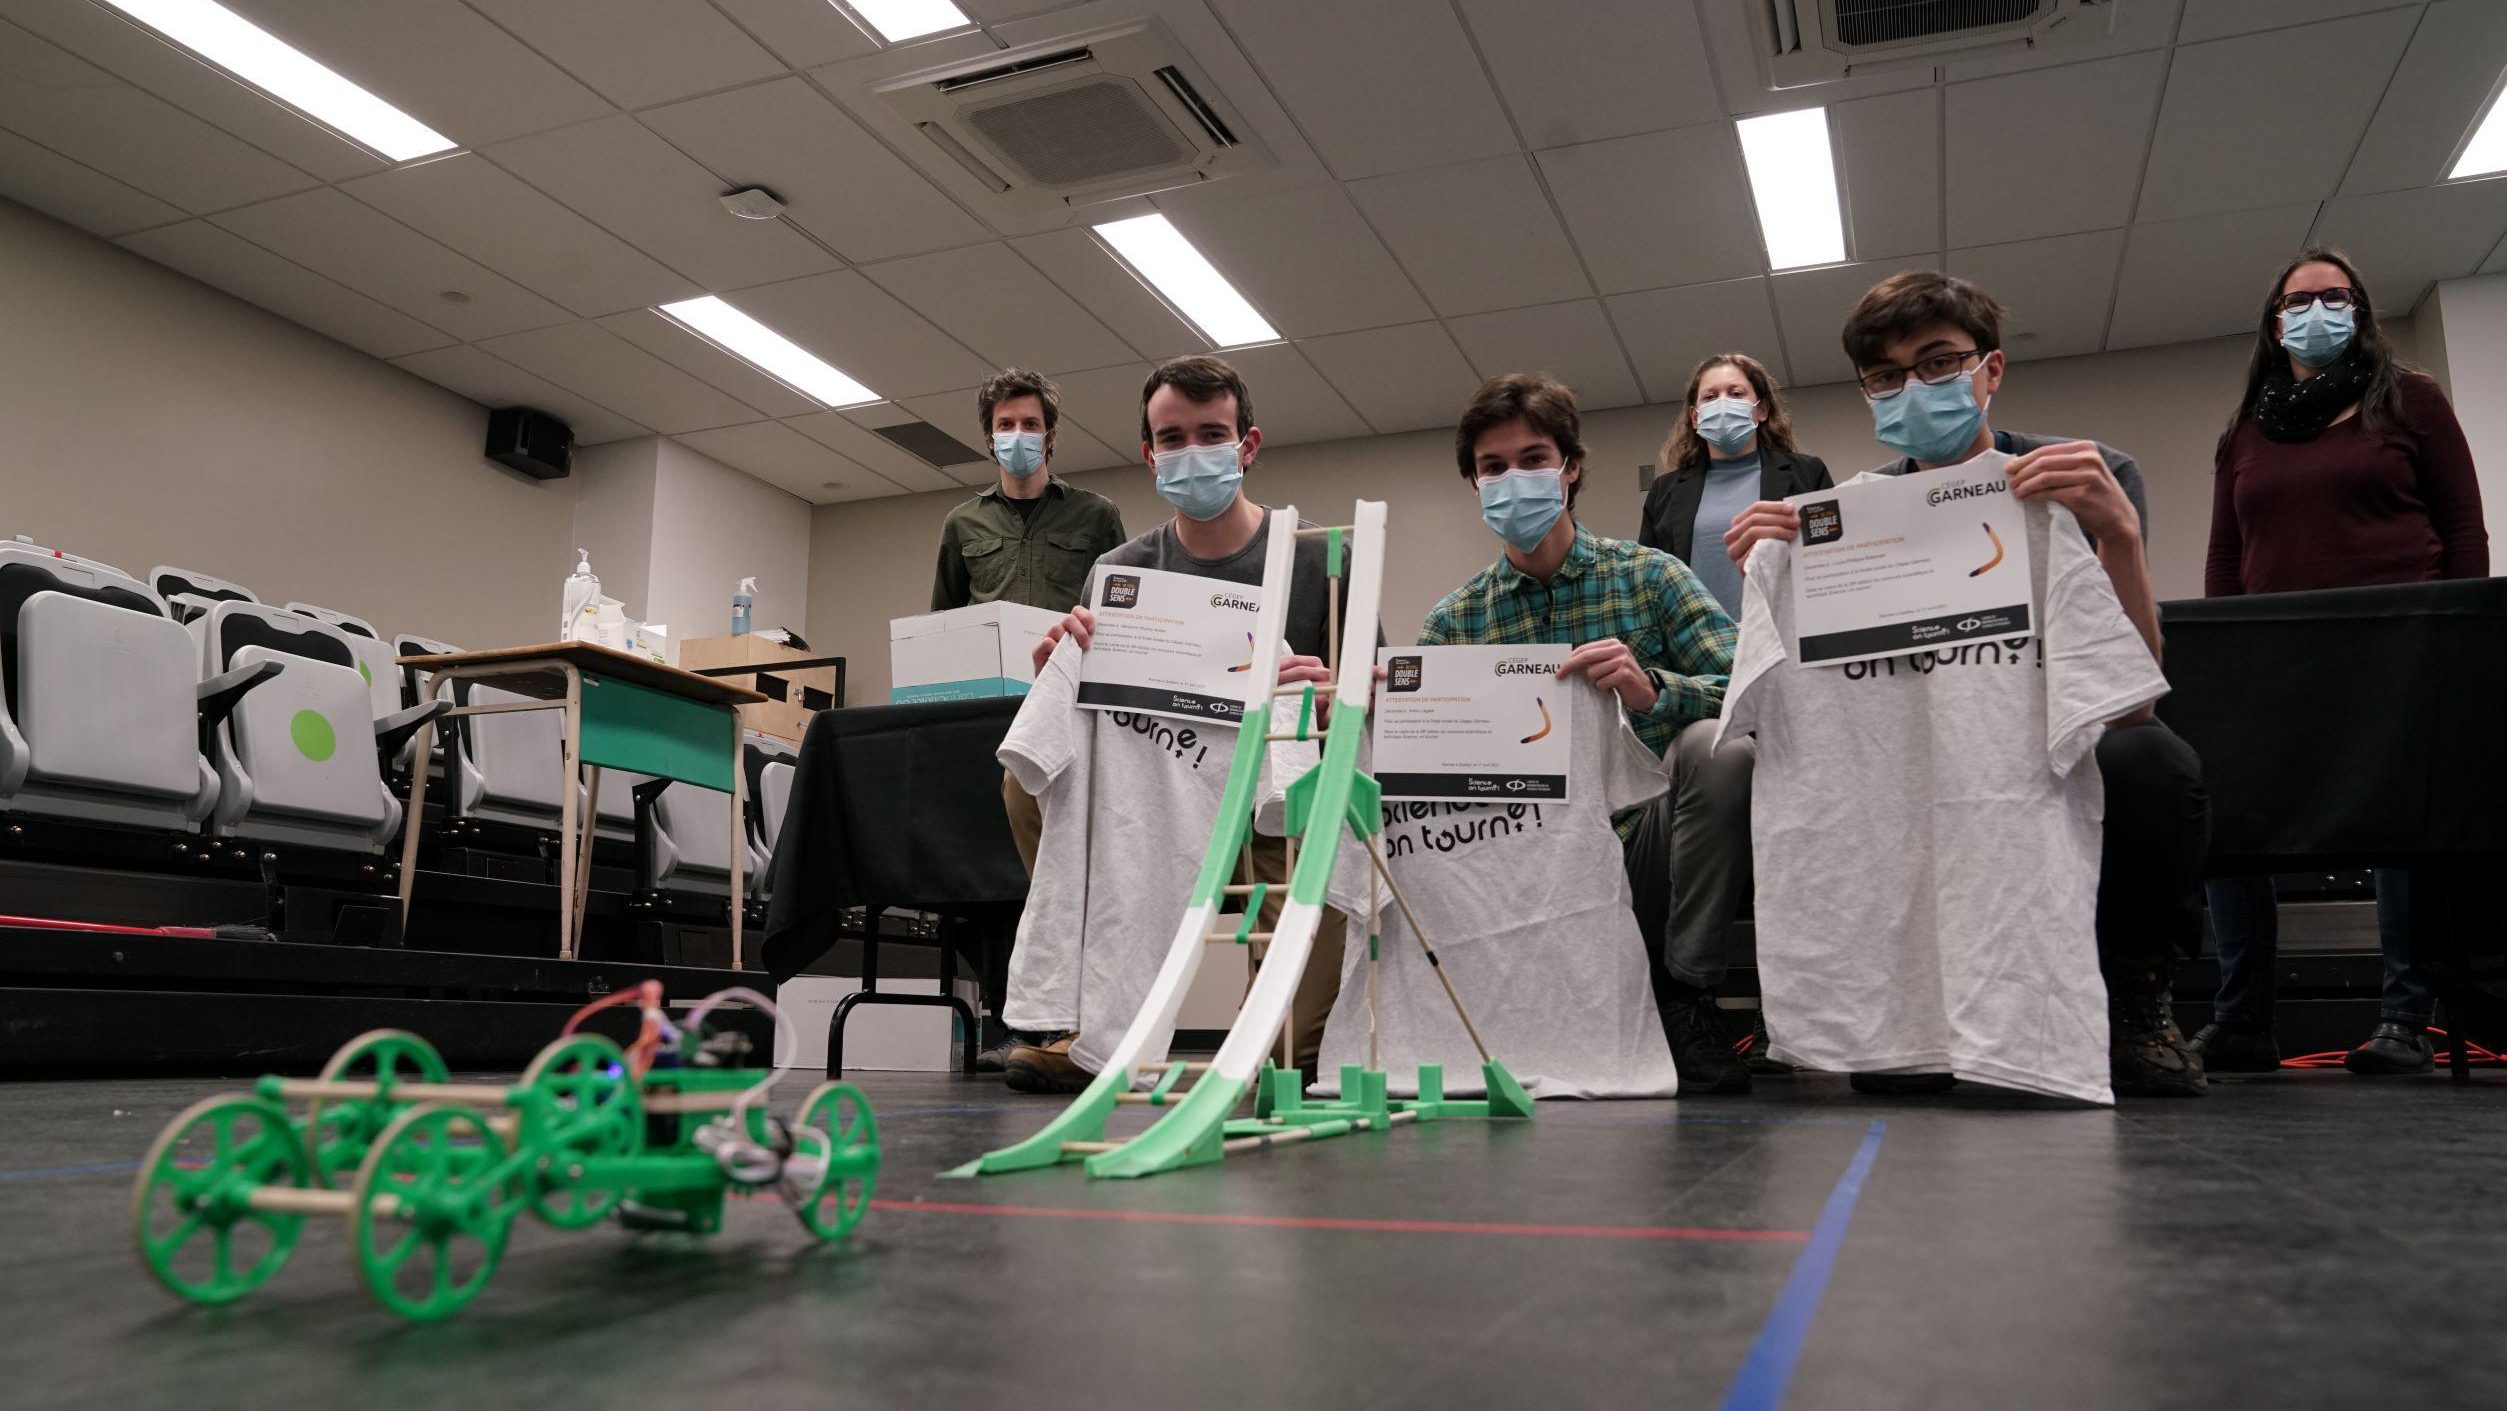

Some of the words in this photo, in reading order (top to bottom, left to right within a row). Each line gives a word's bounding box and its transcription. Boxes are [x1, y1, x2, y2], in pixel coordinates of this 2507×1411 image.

[1929, 480, 2006, 505] GARNEAU
[1809, 515, 1838, 529] DOUBLE
[1110, 586, 1136, 597] DOUBLE
[1109, 594, 1126, 603] SENS
[1911, 625, 1941, 635] Science
[1394, 669, 1420, 678] DOUBLE
[1394, 677, 1410, 686] SENS
[1173, 695, 1196, 705] Science
[1468, 778, 1493, 786] Science
